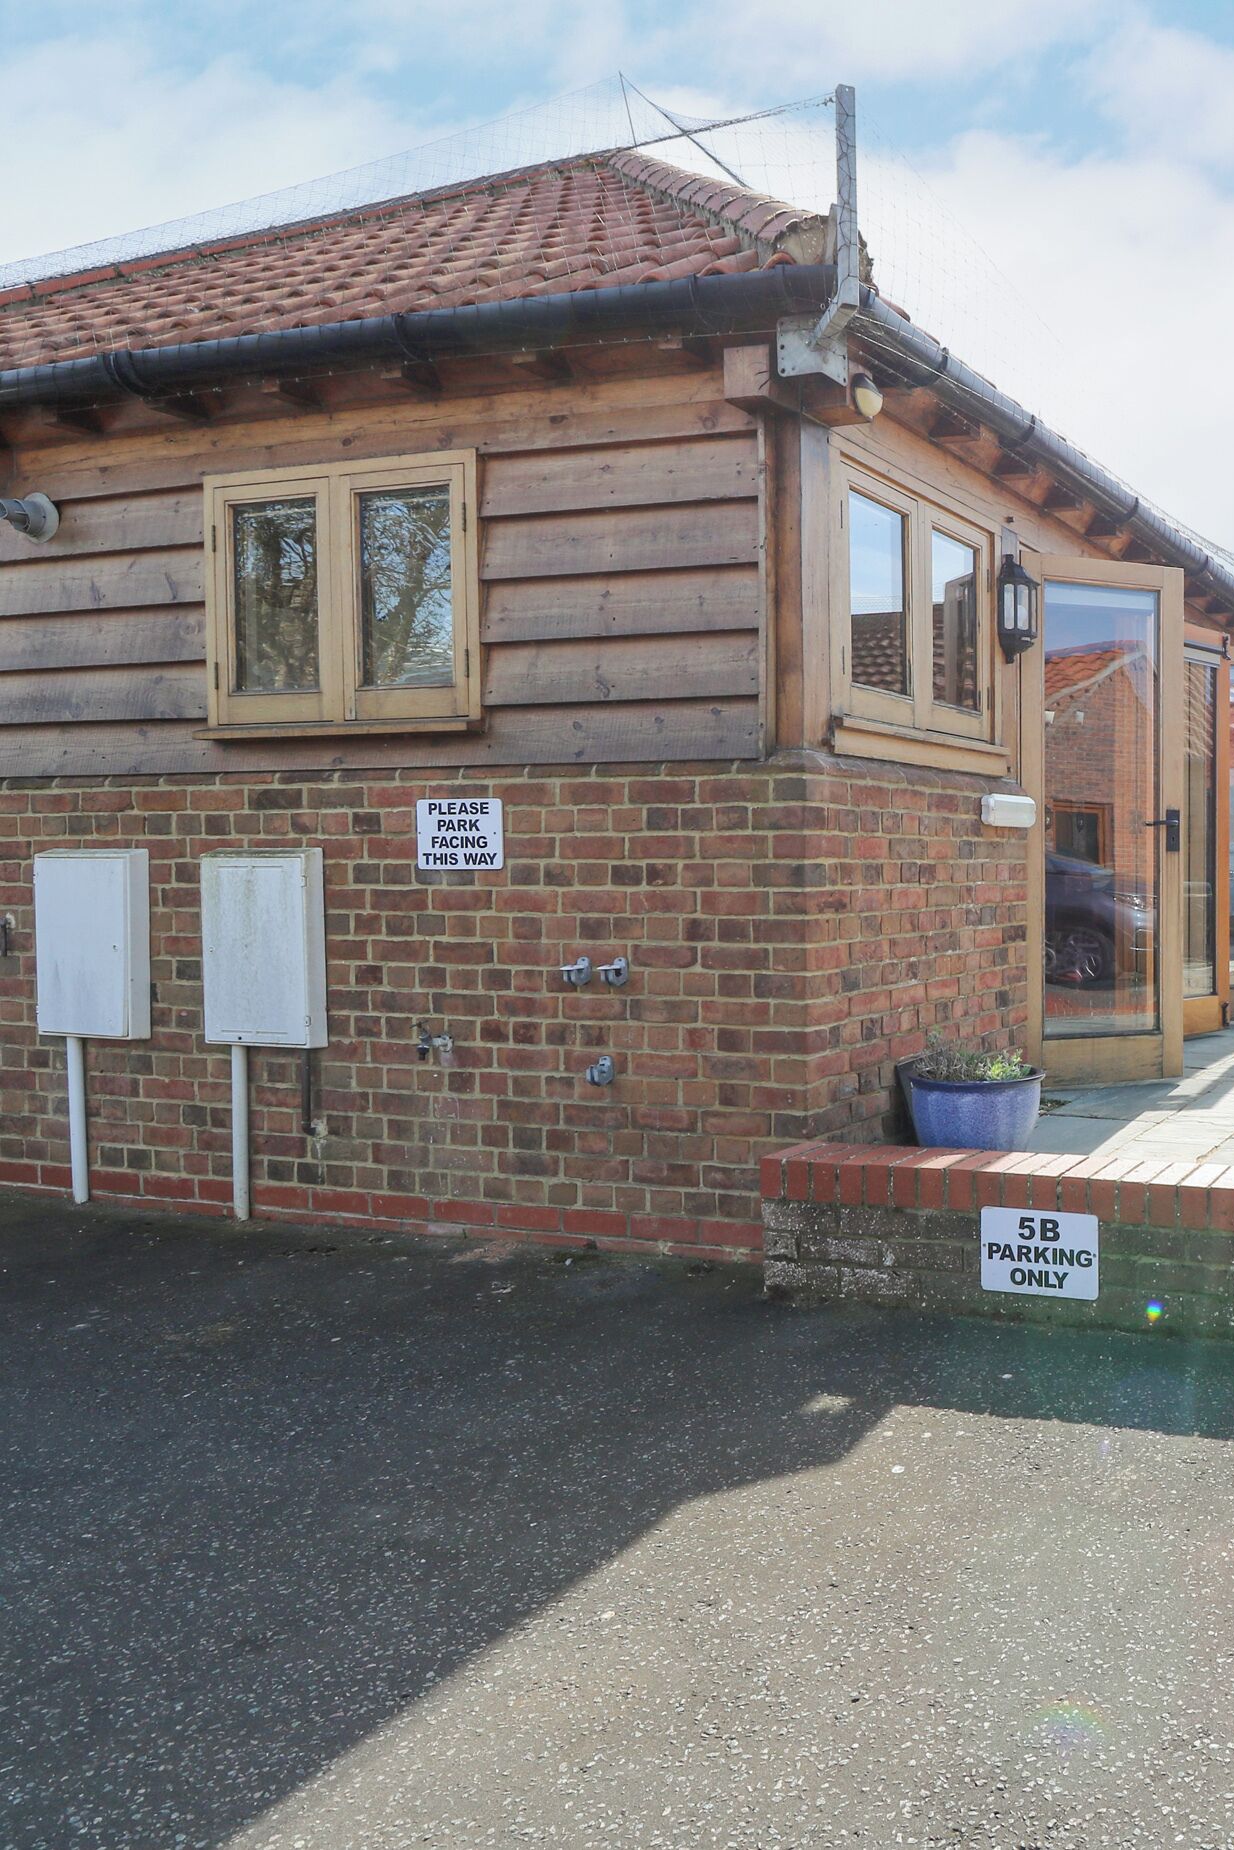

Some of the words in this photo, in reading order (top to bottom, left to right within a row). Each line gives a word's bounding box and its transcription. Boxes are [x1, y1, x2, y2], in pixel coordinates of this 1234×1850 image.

[428, 802, 489, 815] PLEASE
[437, 819, 480, 832] PARK
[431, 836, 488, 849] FACING
[422, 853, 459, 866] THIS
[463, 852, 497, 866] WAY
[1018, 1216, 1060, 1242] 5B
[987, 1242, 1093, 1268] PARKING
[1009, 1267, 1069, 1289] ONLY
